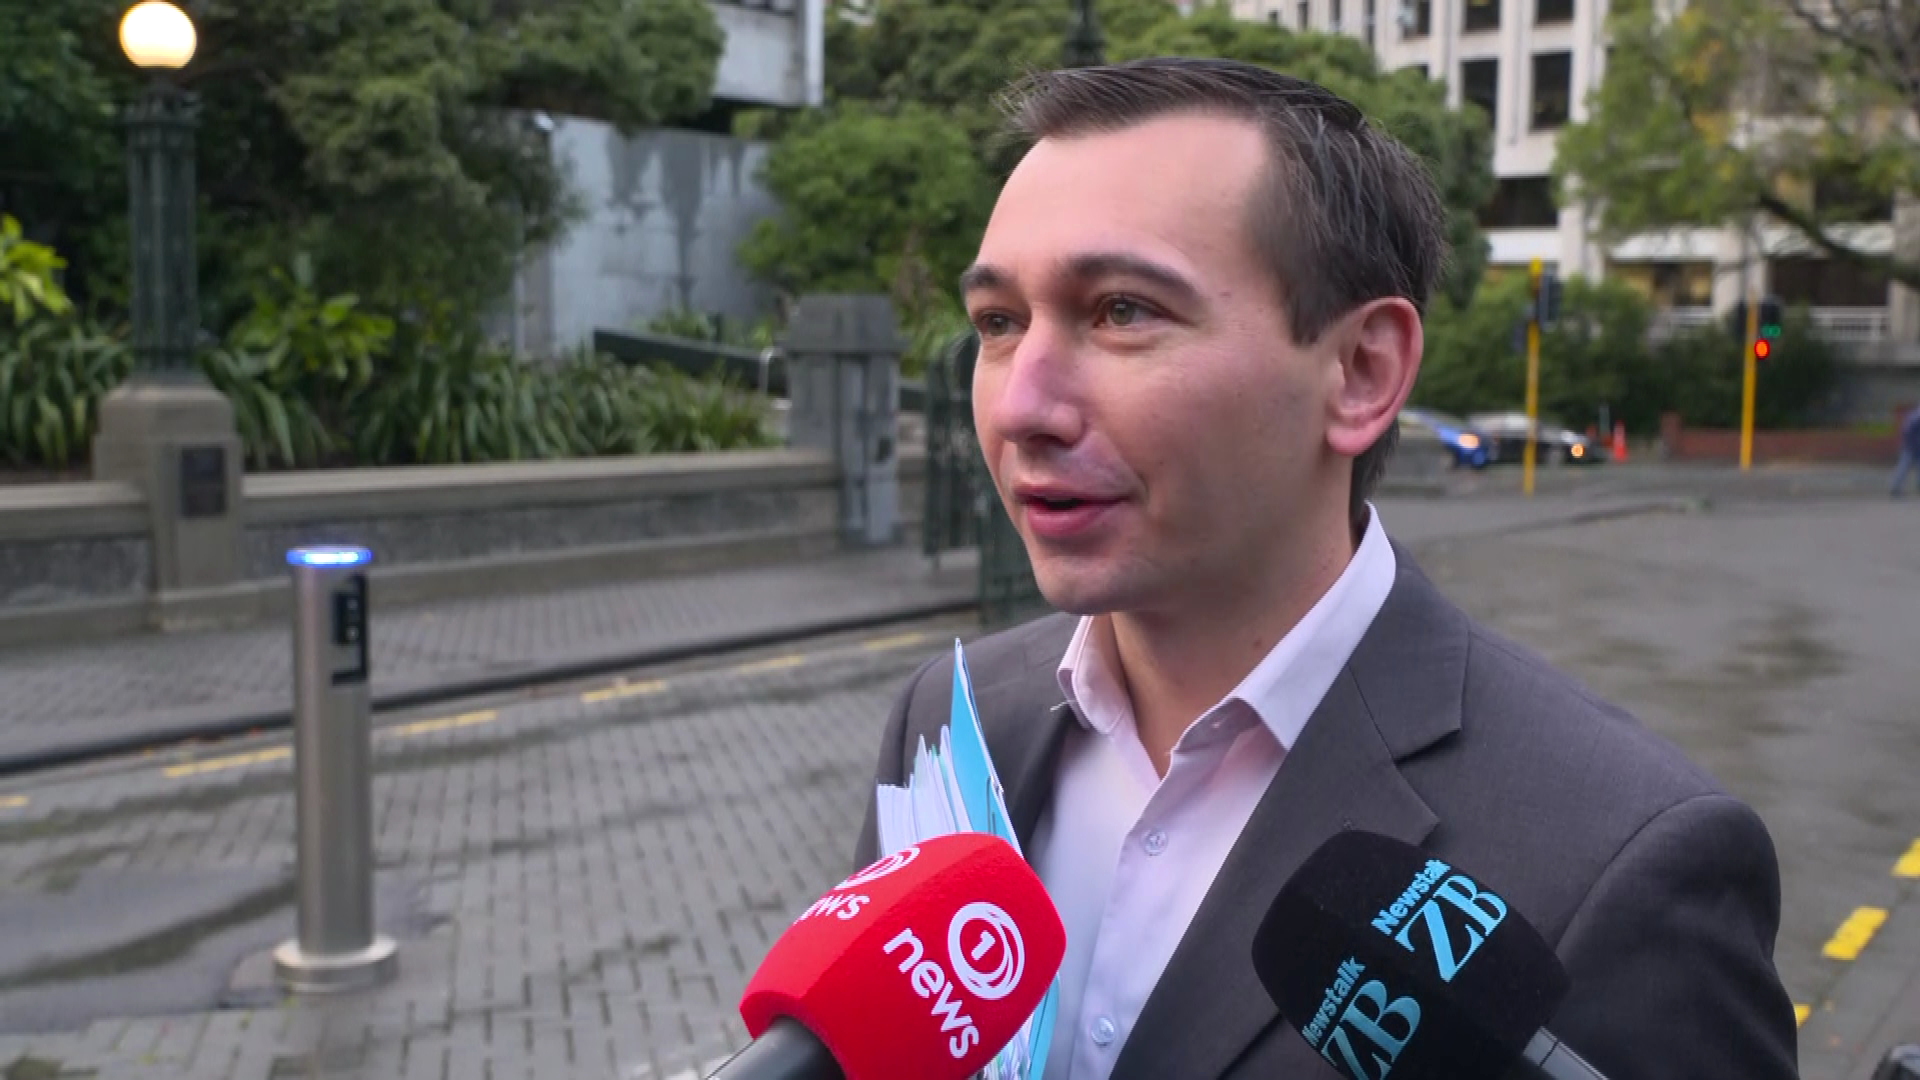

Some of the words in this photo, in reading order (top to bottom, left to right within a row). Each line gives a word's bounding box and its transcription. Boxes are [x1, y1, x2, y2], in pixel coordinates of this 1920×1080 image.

[1394, 875, 1507, 983] ZB
[883, 927, 980, 1059] news
[1321, 979, 1421, 1080] ZB
